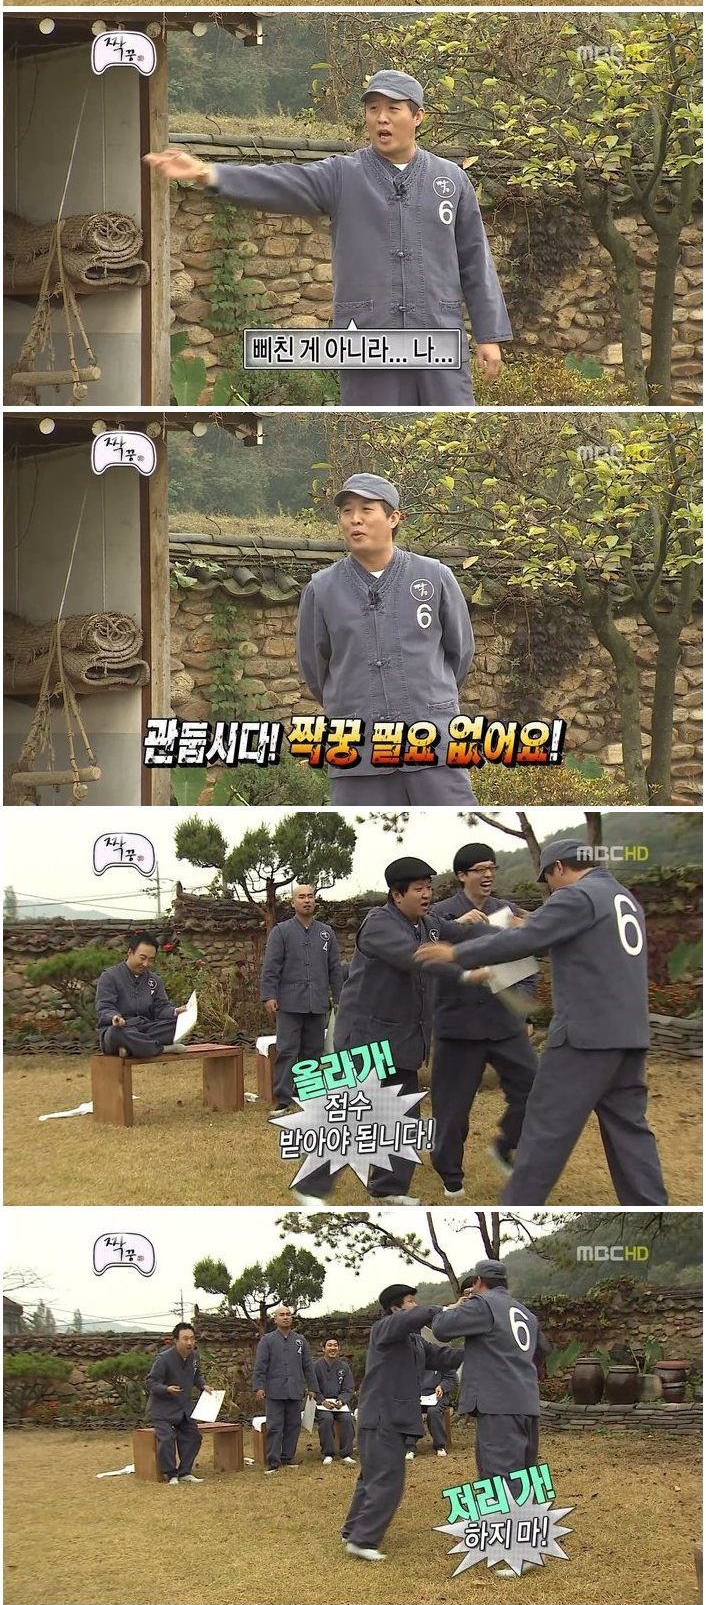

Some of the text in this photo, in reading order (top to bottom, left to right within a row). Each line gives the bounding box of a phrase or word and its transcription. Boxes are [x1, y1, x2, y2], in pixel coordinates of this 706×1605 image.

[438, 201, 454, 225] 6
[416, 601, 432, 629] 6
[613, 892, 645, 956] 6
[508, 1305, 530, 1352] 6
